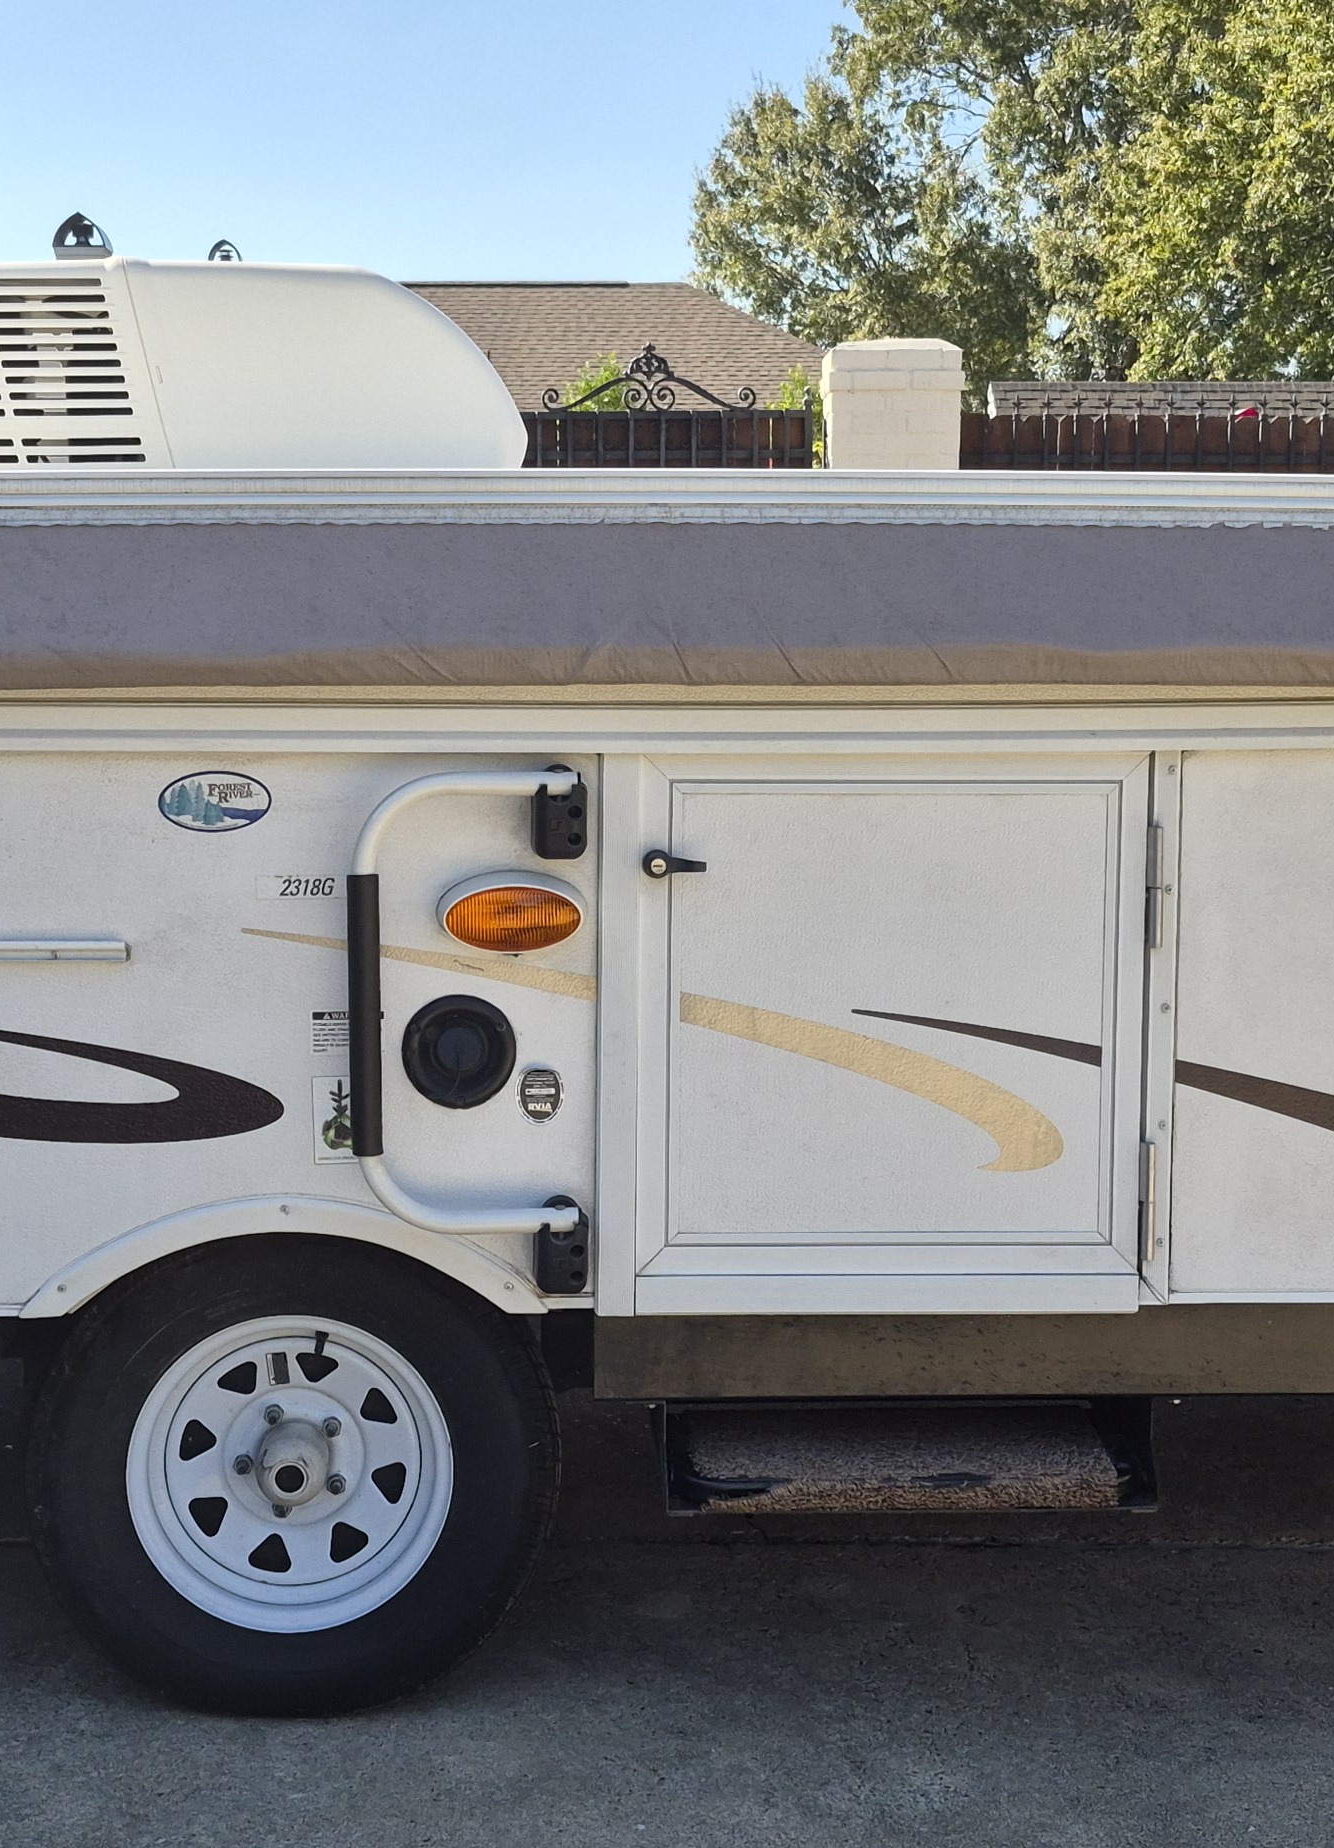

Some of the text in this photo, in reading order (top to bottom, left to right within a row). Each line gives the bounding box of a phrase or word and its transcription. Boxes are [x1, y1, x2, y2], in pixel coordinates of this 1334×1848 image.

[207, 783, 252, 797] FOREST
[217, 789, 253, 803] RIVER
[279, 877, 336, 897] 2318G
